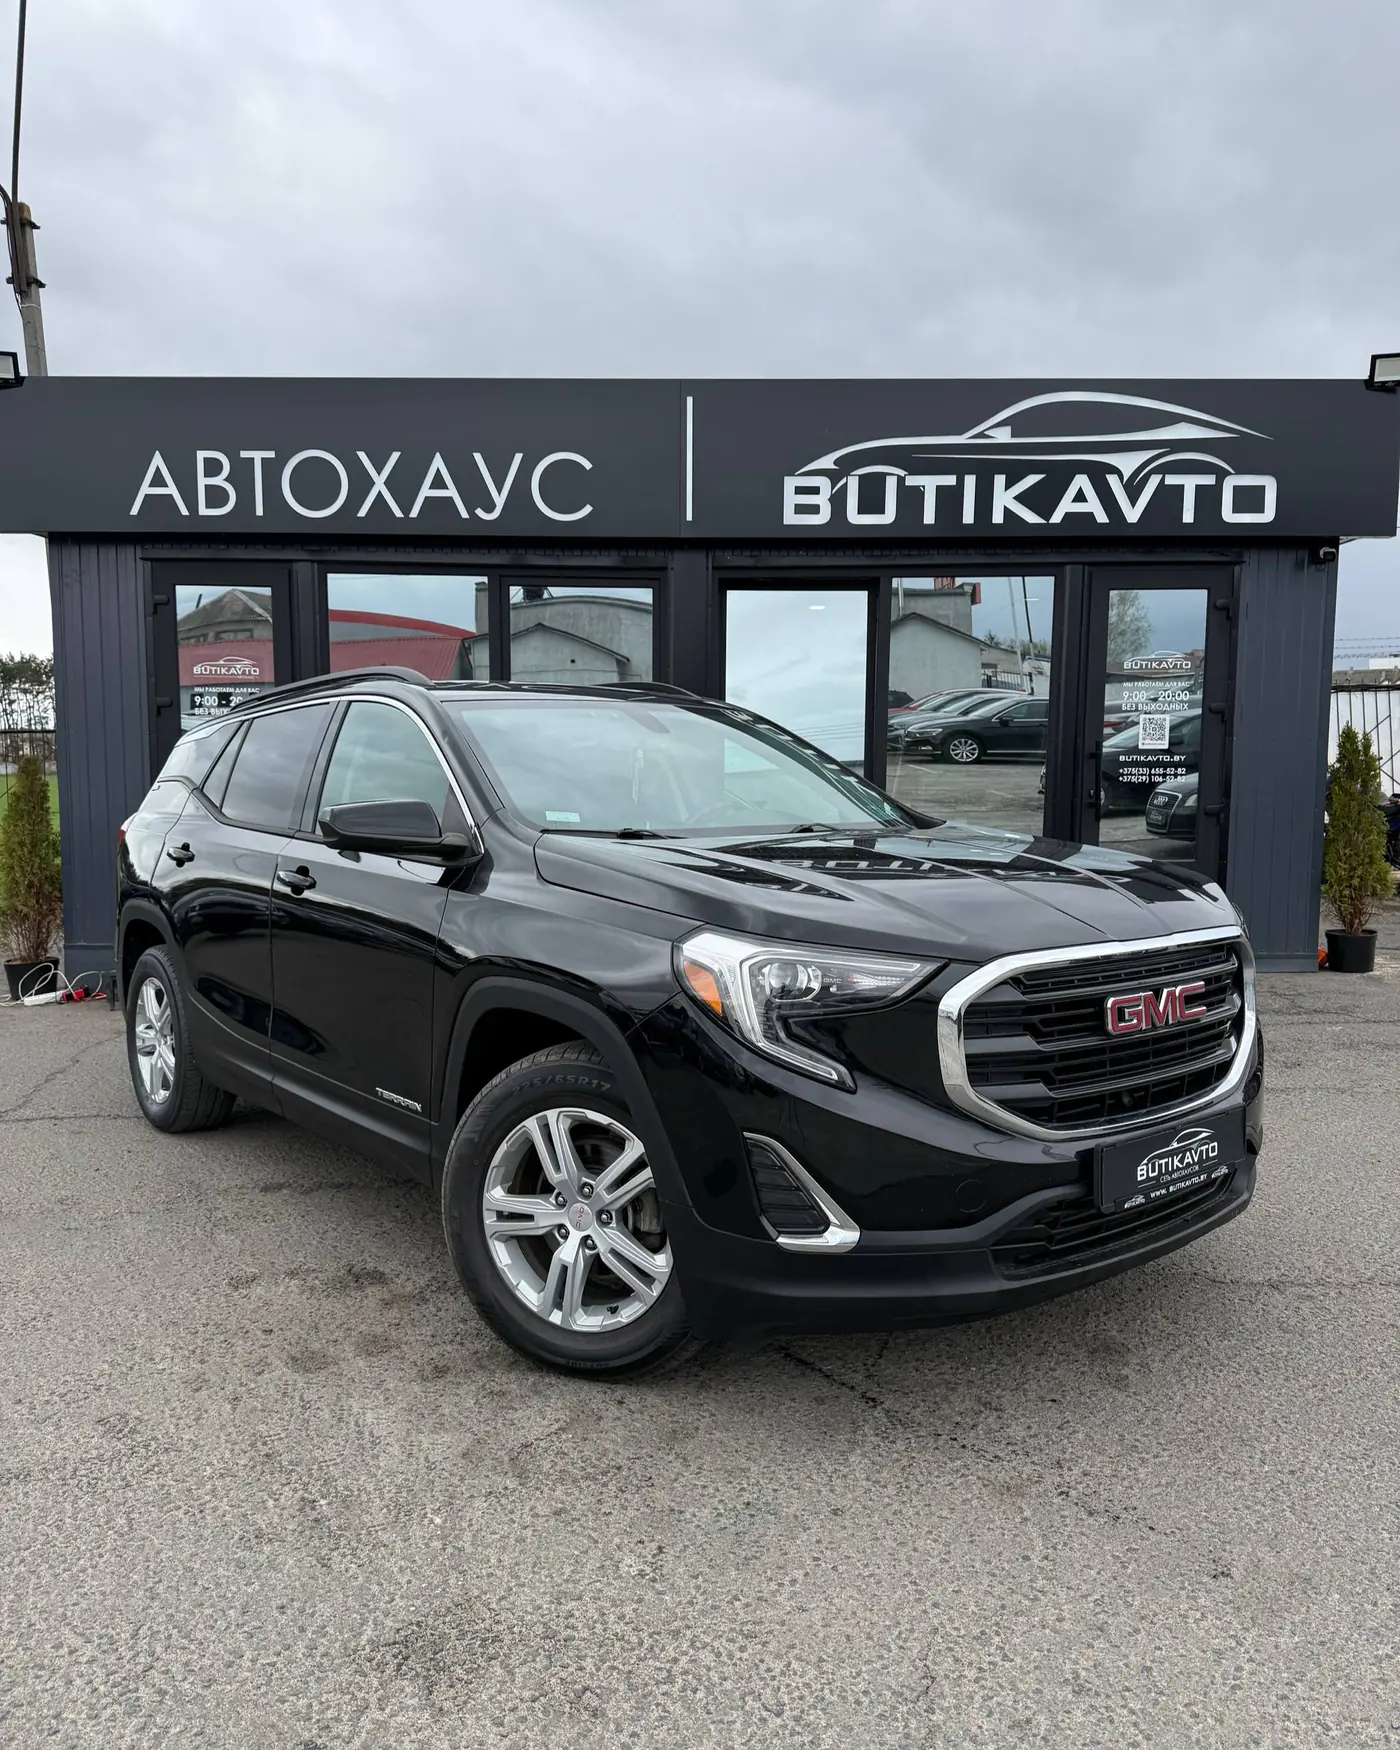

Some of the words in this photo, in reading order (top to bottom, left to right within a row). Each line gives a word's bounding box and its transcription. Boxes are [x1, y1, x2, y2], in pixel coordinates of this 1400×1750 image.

[130, 450, 594, 522] АВТОХАУС
[783, 474, 1278, 525] BUTIKAVTO
[193, 666, 260, 675] BUTIKAVTO
[1123, 661, 1191, 669] BUTIKAVTO
[194, 695, 219, 706] 9:00
[1122, 690, 1147, 701] 9:00
[1158, 690, 1190, 701] 20:00
[194, 707, 209, 715] БЕЗ
[210, 707, 231, 716] ВЫХ
[1121, 702, 1136, 711] БЕЗ
[1137, 702, 1189, 711] ВЫХОДНЫХ
[1106, 981, 1207, 1036] GMC
[375, 1087, 422, 1112] TERRAIN
[1137, 1141, 1218, 1181] BUTIKAVTO
[1169, 1173, 1208, 1193] BUTIKAVTO.BY
